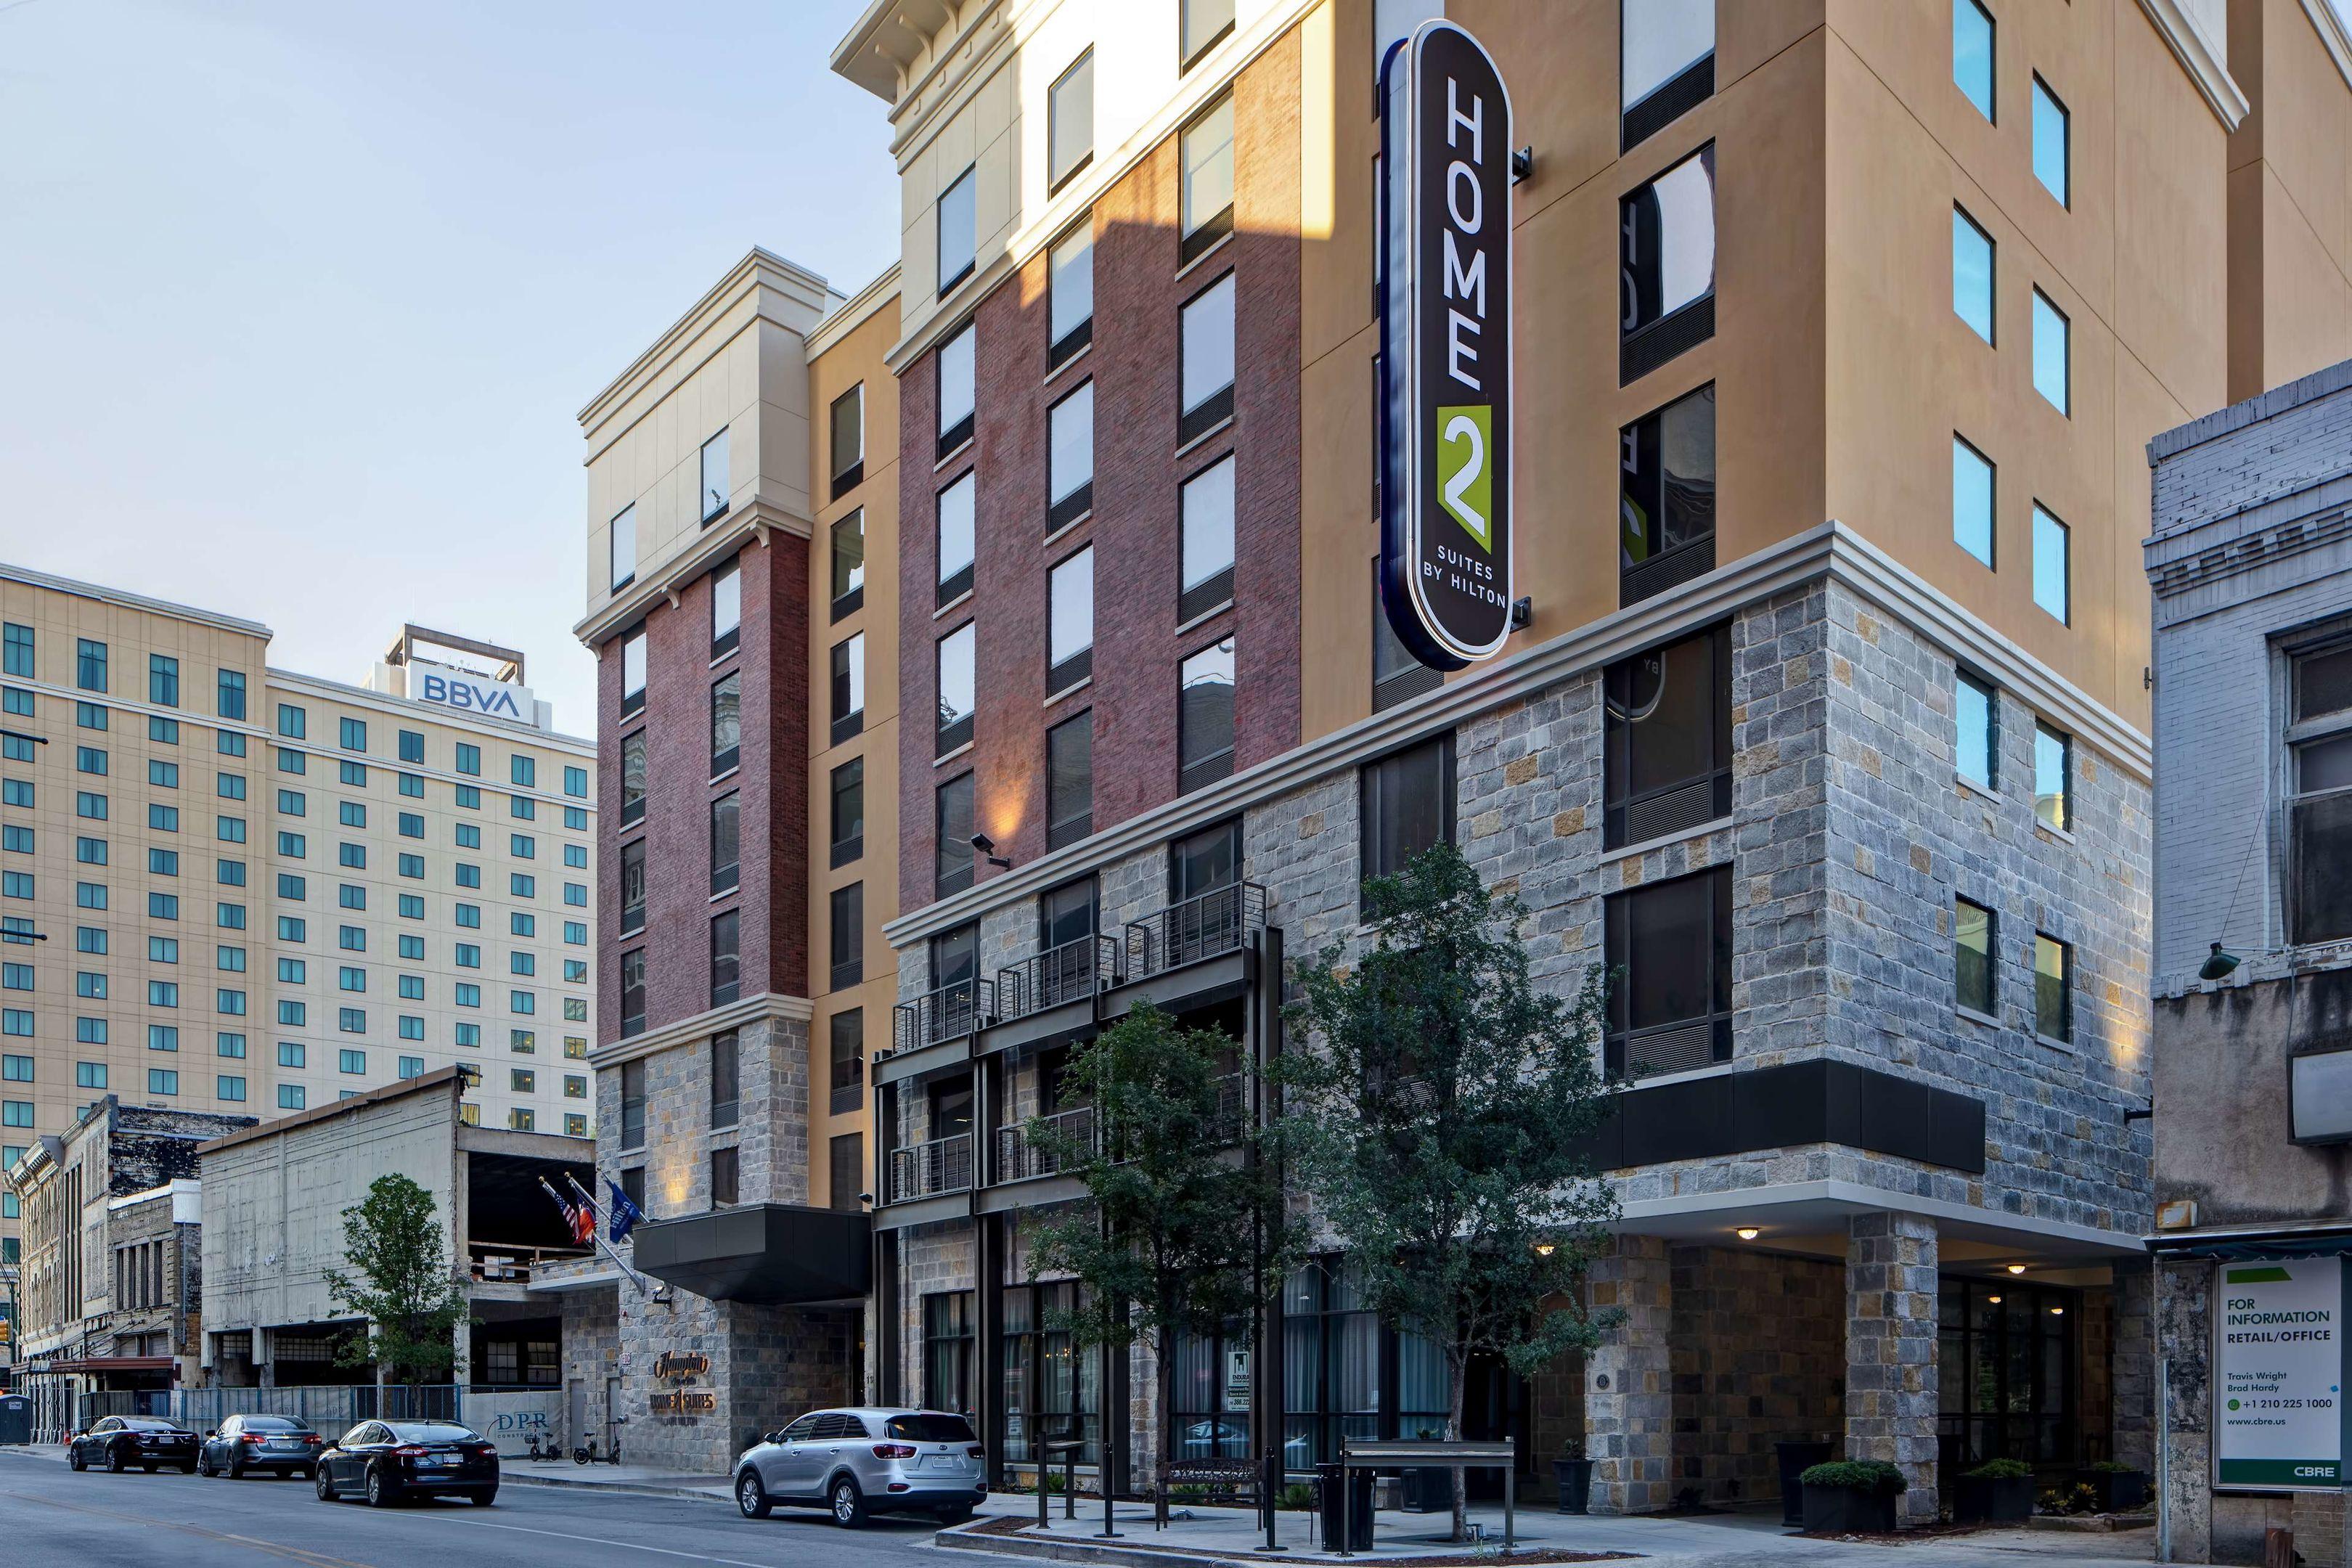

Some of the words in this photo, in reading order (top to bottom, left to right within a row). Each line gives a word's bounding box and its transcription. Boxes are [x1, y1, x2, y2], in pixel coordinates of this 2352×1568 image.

[1443, 75, 1485, 391] HOME
[1444, 415, 1485, 539] 2
[1437, 544, 1493, 581] SUITES
[1424, 561, 1442, 581] BY
[1451, 573, 1506, 609] HILTON
[425, 674, 519, 717] BBVA
[611, 1201, 631, 1228] Hilton
[2228, 1299, 2255, 1310] FOR
[2228, 1310, 2330, 1326] INFORMATION
[2228, 1330, 2331, 1344] RETAIL/OFFICE
[2256, 1372, 2287, 1381] Wright
[497, 1413, 550, 1430] DPR
[2294, 1466, 2335, 1477] CBRE
